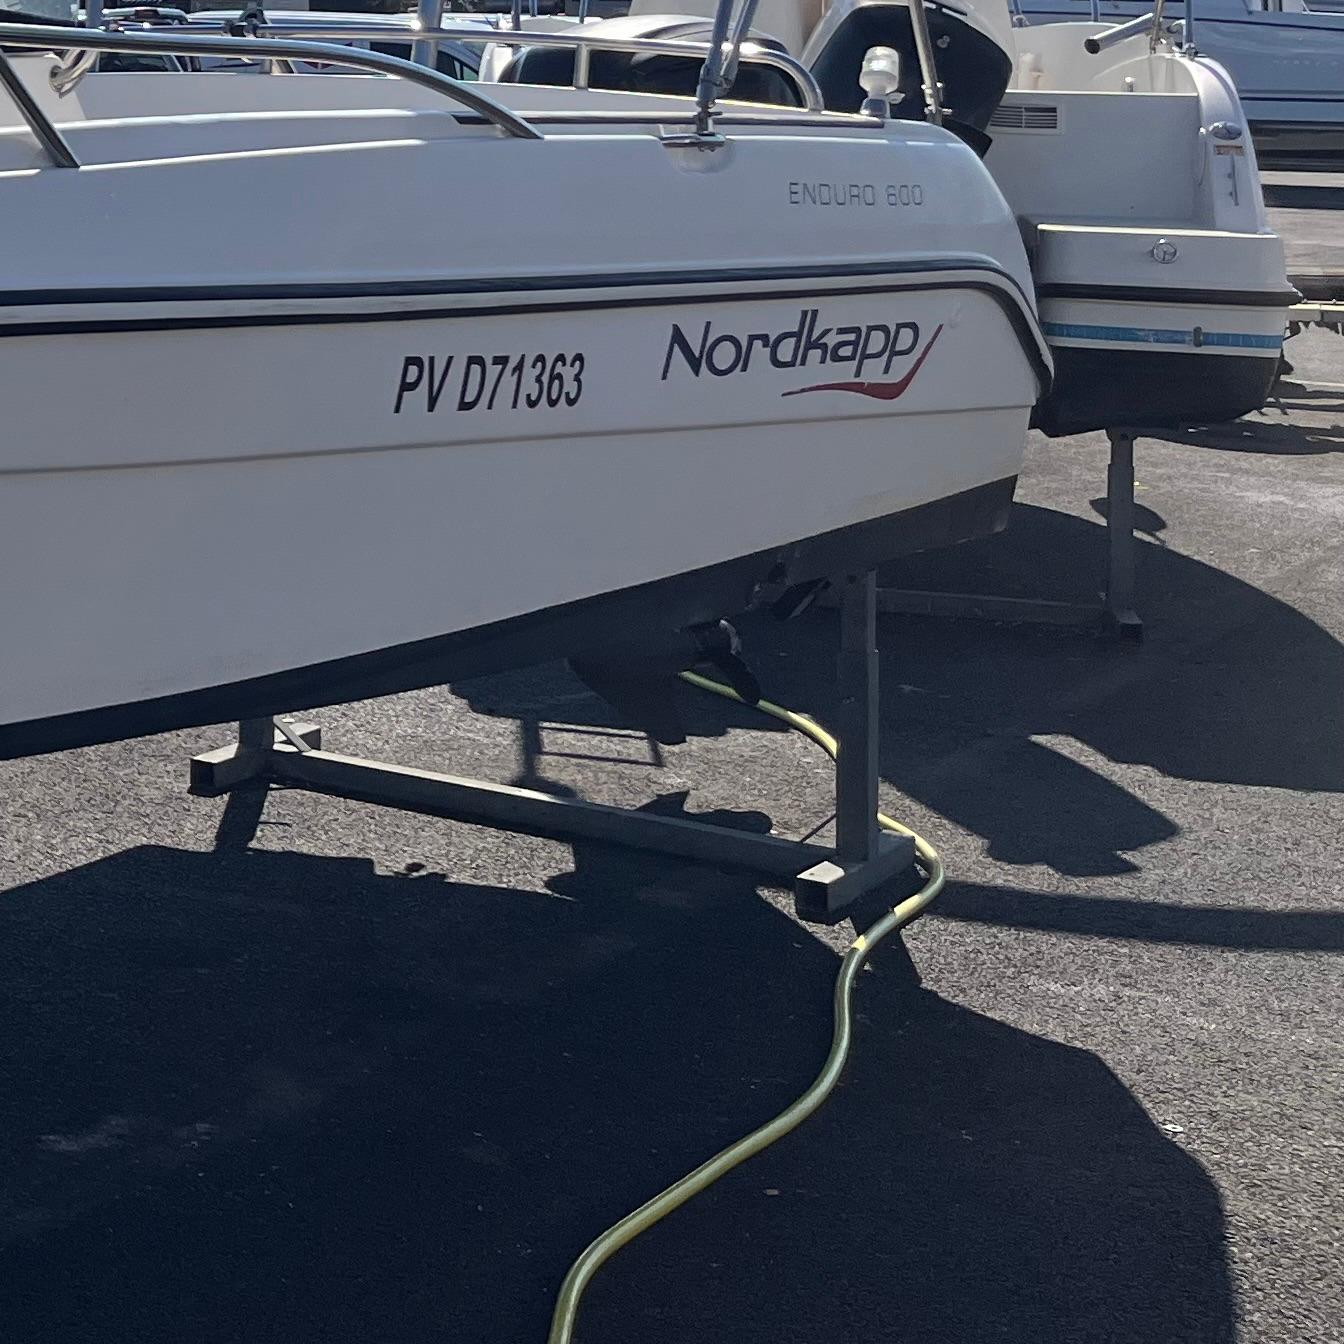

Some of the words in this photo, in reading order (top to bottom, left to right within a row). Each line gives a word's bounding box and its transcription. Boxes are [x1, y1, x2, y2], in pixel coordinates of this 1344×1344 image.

[789, 182, 875, 206] ENDURO
[885, 184, 923, 206] 600
[661, 309, 920, 381] Nordkapp
[394, 355, 453, 414] PV
[457, 353, 585, 412] D71363
